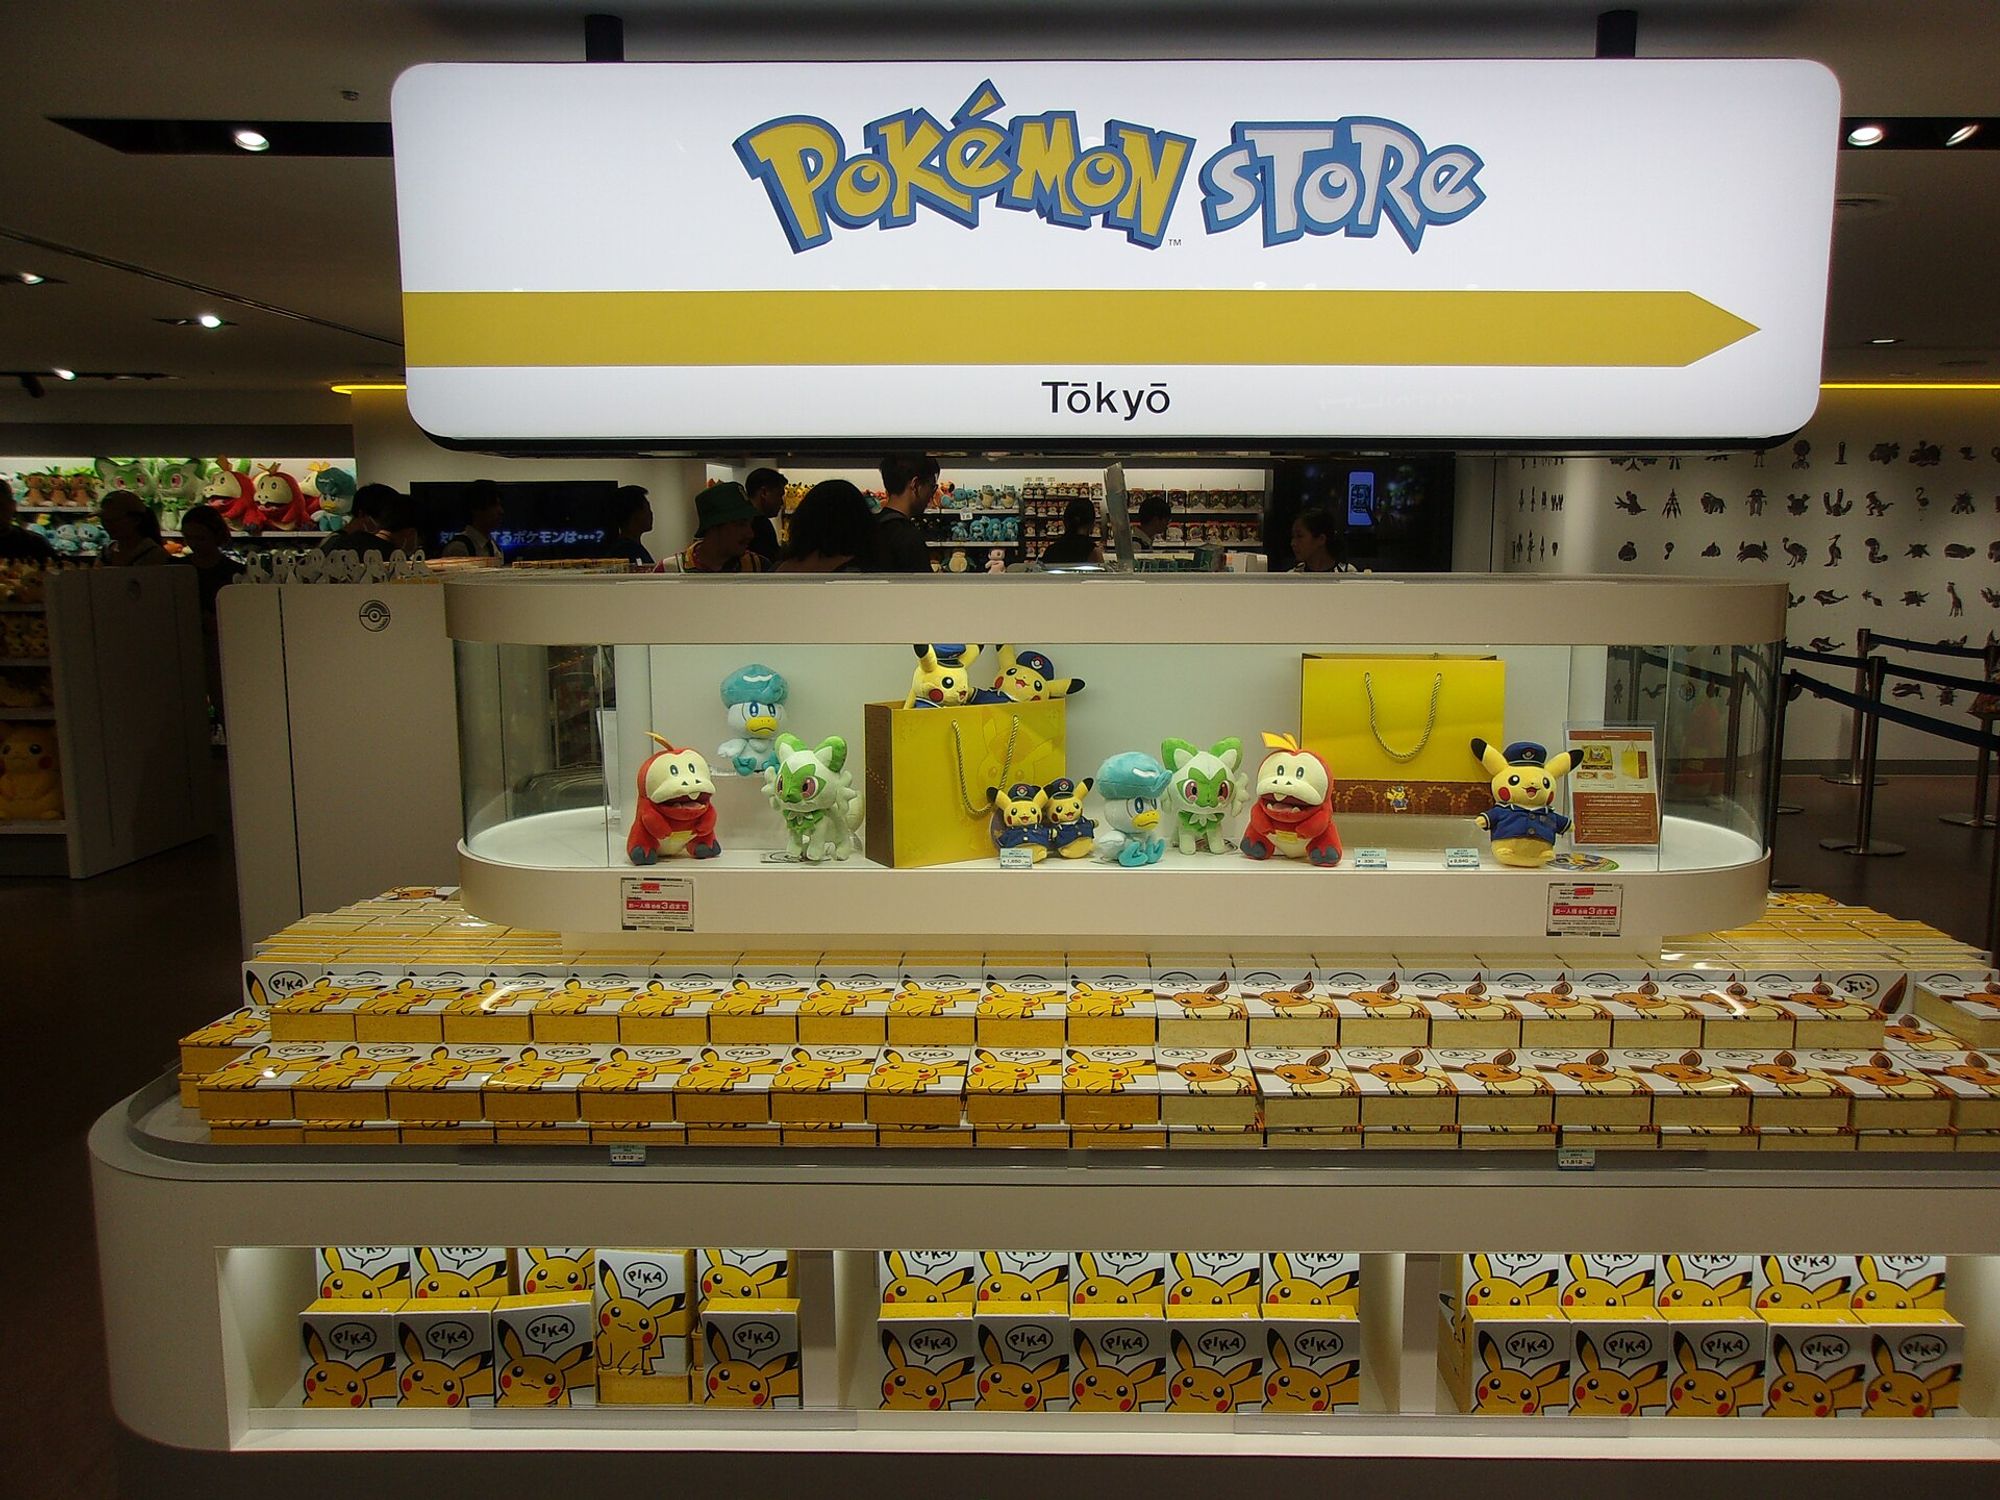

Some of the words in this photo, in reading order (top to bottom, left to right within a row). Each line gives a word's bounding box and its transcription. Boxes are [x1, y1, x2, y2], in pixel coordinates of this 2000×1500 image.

[1041, 381, 1170, 421] Tōkyō
[273, 976, 303, 991] PIKA
[628, 1269, 662, 1283] PIKA
[431, 1329, 468, 1344] PIKA
[530, 1323, 569, 1337] PIKA
[737, 1330, 774, 1344] PIKA
[334, 1330, 371, 1345] PIKA
[914, 1336, 951, 1350] PIKA
[1010, 1332, 1047, 1346] PIKA
[1105, 1336, 1143, 1350] PIKA
[1202, 1337, 1239, 1351] PIKA
[1299, 1337, 1337, 1352] PIKA
[1510, 1338, 1547, 1353] PIKA
[1608, 1338, 1645, 1353] PIKA
[1705, 1339, 1743, 1353] PIKA
[1805, 1342, 1844, 1356] PIKA
[1905, 1341, 1943, 1356] PIKA
